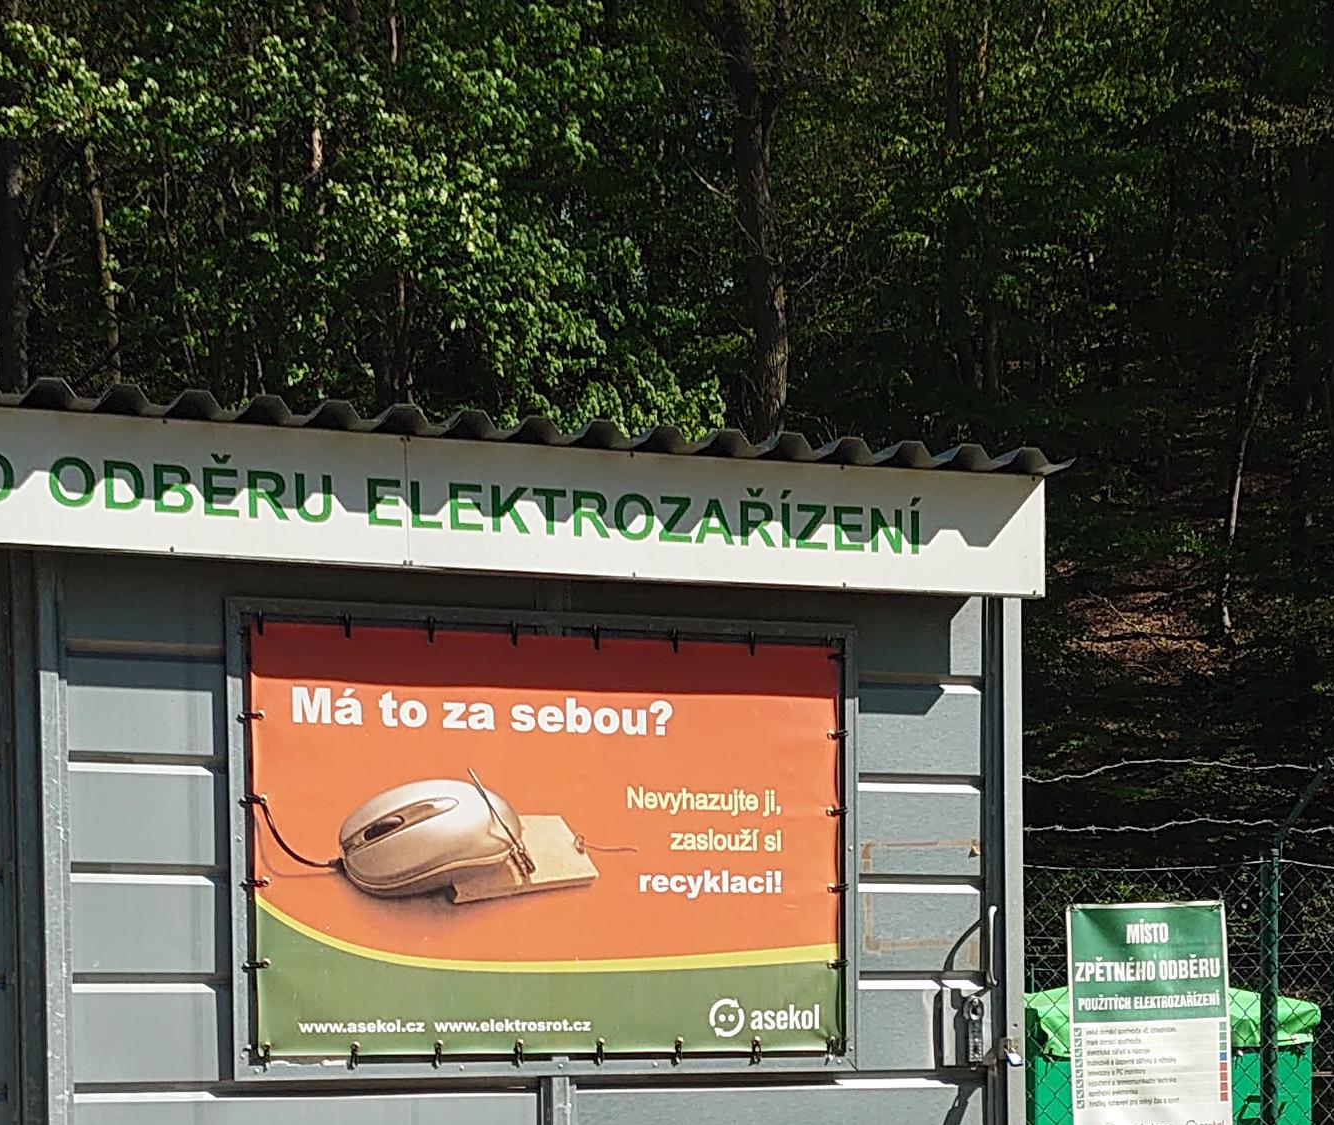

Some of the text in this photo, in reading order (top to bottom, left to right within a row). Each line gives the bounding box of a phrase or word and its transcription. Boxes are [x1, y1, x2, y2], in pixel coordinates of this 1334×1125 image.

[48, 453, 333, 524] ODBĚRU
[367, 477, 921, 555] ELEKTROZAŘÍZENÍ
[291, 686, 673, 737] Má to za sebou?
[626, 786, 782, 817] Nevyhazujte ji,
[670, 828, 783, 852] zaslouží si
[639, 869, 783, 899] recyklaci!
[1125, 918, 1170, 945] MÍSTO
[1074, 953, 1221, 982] ZPĚTNÉHO ODBĚRU
[1078, 989, 1220, 1011] POUŽITÝCH ELEKTROZAŘÍZENÍ
[298, 1017, 592, 1035] www.asekol.cz www.elektrosrot.cz
[750, 1003, 820, 1031] asekol
